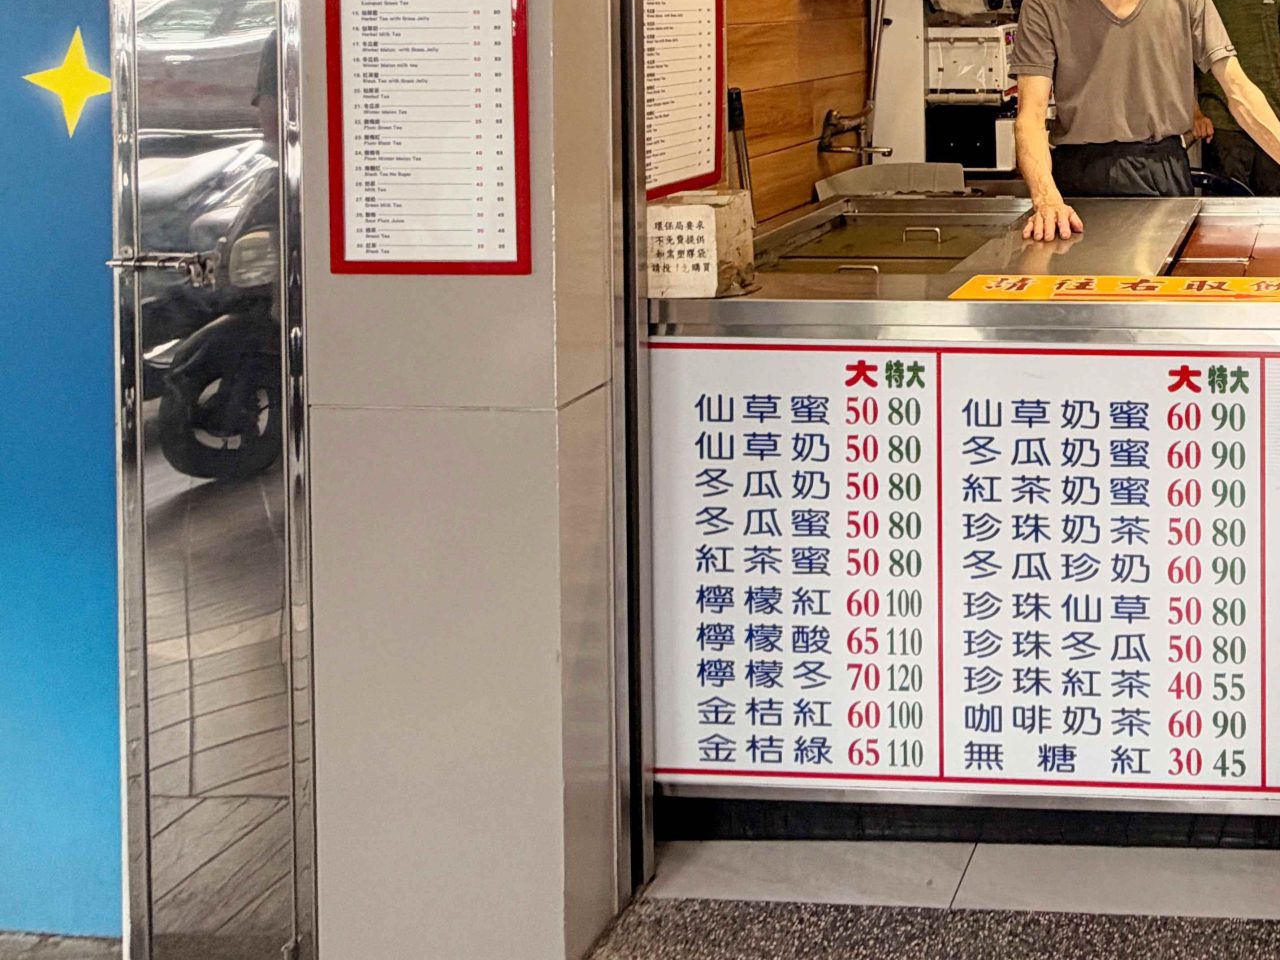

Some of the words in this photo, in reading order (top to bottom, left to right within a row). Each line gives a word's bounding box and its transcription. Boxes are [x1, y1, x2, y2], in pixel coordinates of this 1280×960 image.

[845, 360, 878, 388] 大
[885, 360, 925, 388] 特大
[1168, 365, 1202, 393] 大
[1208, 365, 1249, 394] 特大
[695, 394, 829, 425] 仙草蜜
[846, 397, 878, 425] 50
[888, 397, 921, 425] 80
[962, 398, 1149, 431] 仙草奶蜜
[1167, 403, 1201, 430] 60
[1212, 403, 1245, 431] 90
[695, 431, 829, 462] 仙草奶
[846, 435, 878, 462] 50
[888, 435, 921, 463] 80
[962, 436, 1150, 469] 冬瓜奶蜜
[1167, 441, 1201, 469] 60
[1212, 441, 1245, 469] 90
[695, 468, 830, 499] 冬瓜奶
[846, 472, 879, 500] 50
[889, 473, 921, 501] 80
[962, 474, 1150, 507] 紅茶奶蜜
[1168, 479, 1201, 507] 60
[1212, 480, 1245, 508] 90
[696, 507, 830, 538] 冬瓜蜜
[846, 511, 879, 538] 50
[889, 511, 921, 539] 80
[962, 513, 1150, 545] 珍珠奶茶
[1168, 518, 1201, 545] 50
[1212, 519, 1245, 546] 80
[696, 544, 830, 576] 紅茶蜜
[847, 548, 879, 576] 50
[889, 549, 922, 577] 80
[963, 550, 1150, 583] 冬瓜珍奶
[1168, 556, 1201, 584] 60
[1212, 557, 1245, 585] 90
[696, 584, 831, 616] 檸檬紅
[847, 589, 879, 617] 60
[887, 589, 922, 617] 100
[963, 591, 1150, 624] 珍珠仙草
[1168, 597, 1201, 624] 50
[1213, 598, 1246, 626] 80
[696, 622, 832, 654] 檸檬酸
[847, 627, 878, 654] 65
[887, 628, 922, 655] 110
[963, 629, 1150, 662] 珍珠冬瓜
[1168, 635, 1202, 663] 50
[1213, 636, 1246, 664] 80
[697, 658, 831, 689] 檸檬冬
[847, 663, 880, 691] 70
[888, 664, 922, 692] 120
[964, 666, 1150, 699] 珍珠紅茶
[1168, 672, 1202, 700] 40
[1213, 673, 1245, 701] 55
[697, 696, 832, 727] 金桔紅
[848, 701, 880, 728] 60
[888, 701, 923, 729] 100
[965, 704, 1151, 737] 咖啡奶茶
[1168, 710, 1202, 738] 60
[1213, 711, 1246, 739] 90
[698, 734, 832, 764] 金桔綠
[848, 739, 880, 766] 65
[888, 740, 923, 767] 110
[1168, 748, 1202, 776] 30
[1213, 749, 1246, 777] 45
